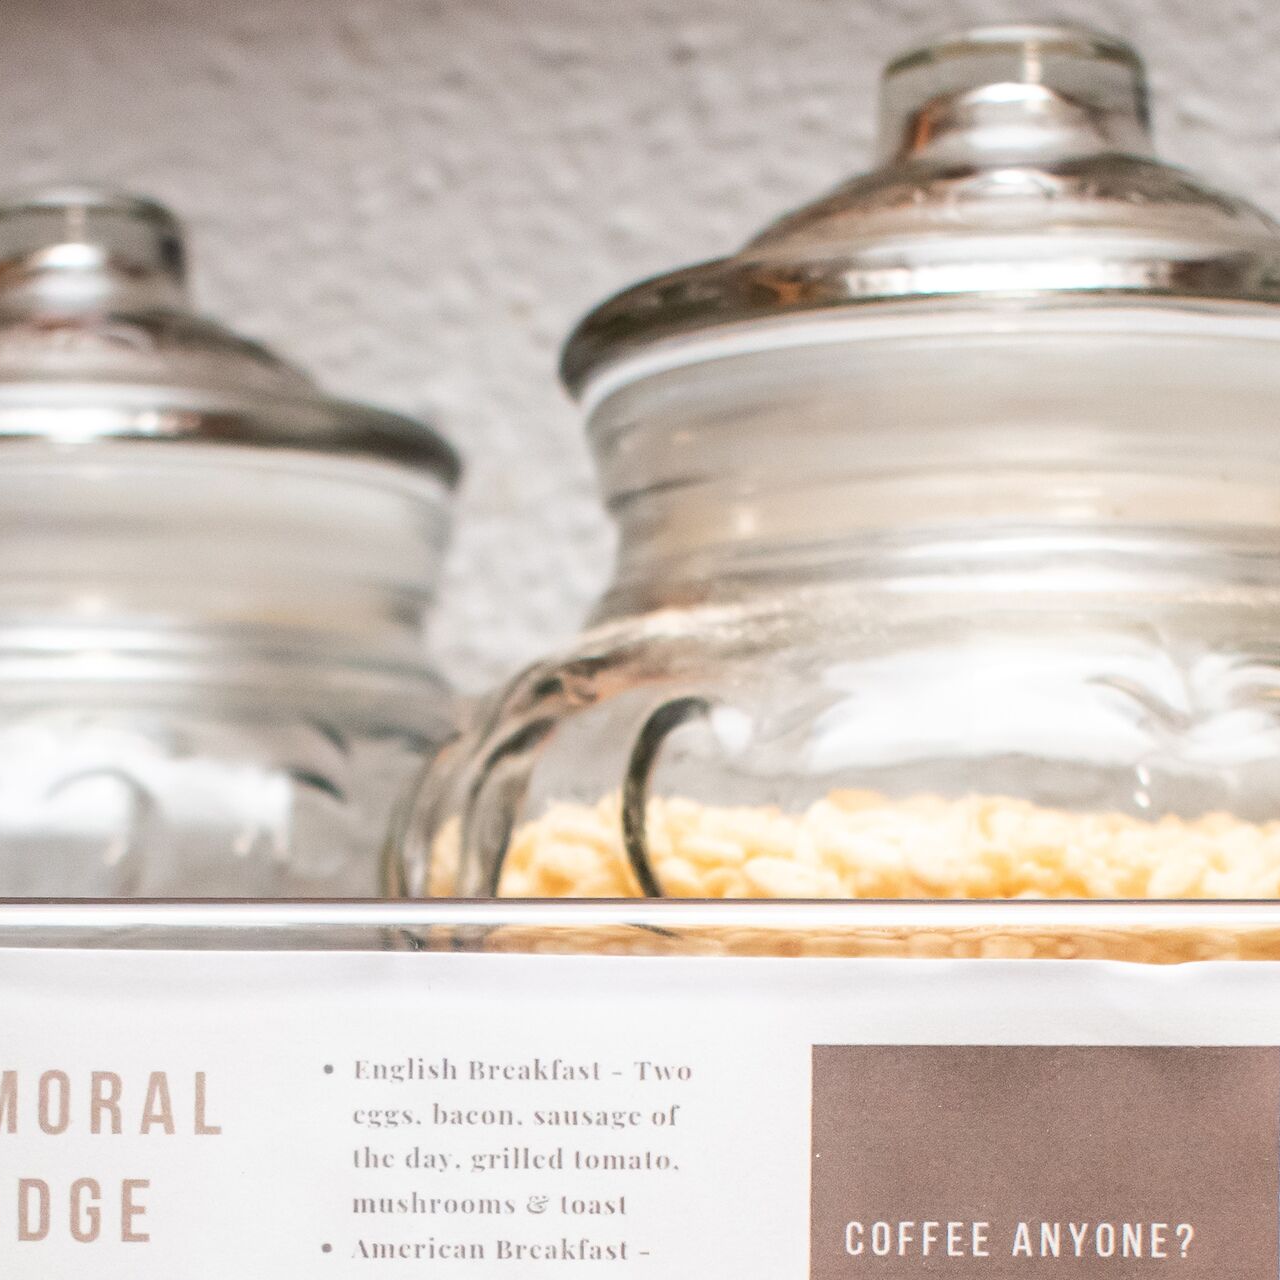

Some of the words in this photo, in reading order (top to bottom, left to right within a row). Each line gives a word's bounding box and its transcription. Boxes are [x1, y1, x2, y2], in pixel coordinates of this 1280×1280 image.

[354, 1058, 457, 1083] English
[469, 1058, 601, 1082] Breakfast
[634, 1061, 693, 1082] Two
[534, 1110, 642, 1129] sausage
[651, 1105, 680, 1127] of
[353, 1146, 395, 1169] the
[471, 1147, 563, 1172] grilled
[353, 1192, 515, 1215] mushrooms
[526, 1195, 550, 1215] &
[561, 1196, 627, 1215] toast
[353, 1237, 484, 1260] American
[496, 1238, 628, 1261] Breakfast
[845, 1221, 990, 1257] COFFEE
[1012, 1222, 1195, 1259] ANYONE?
